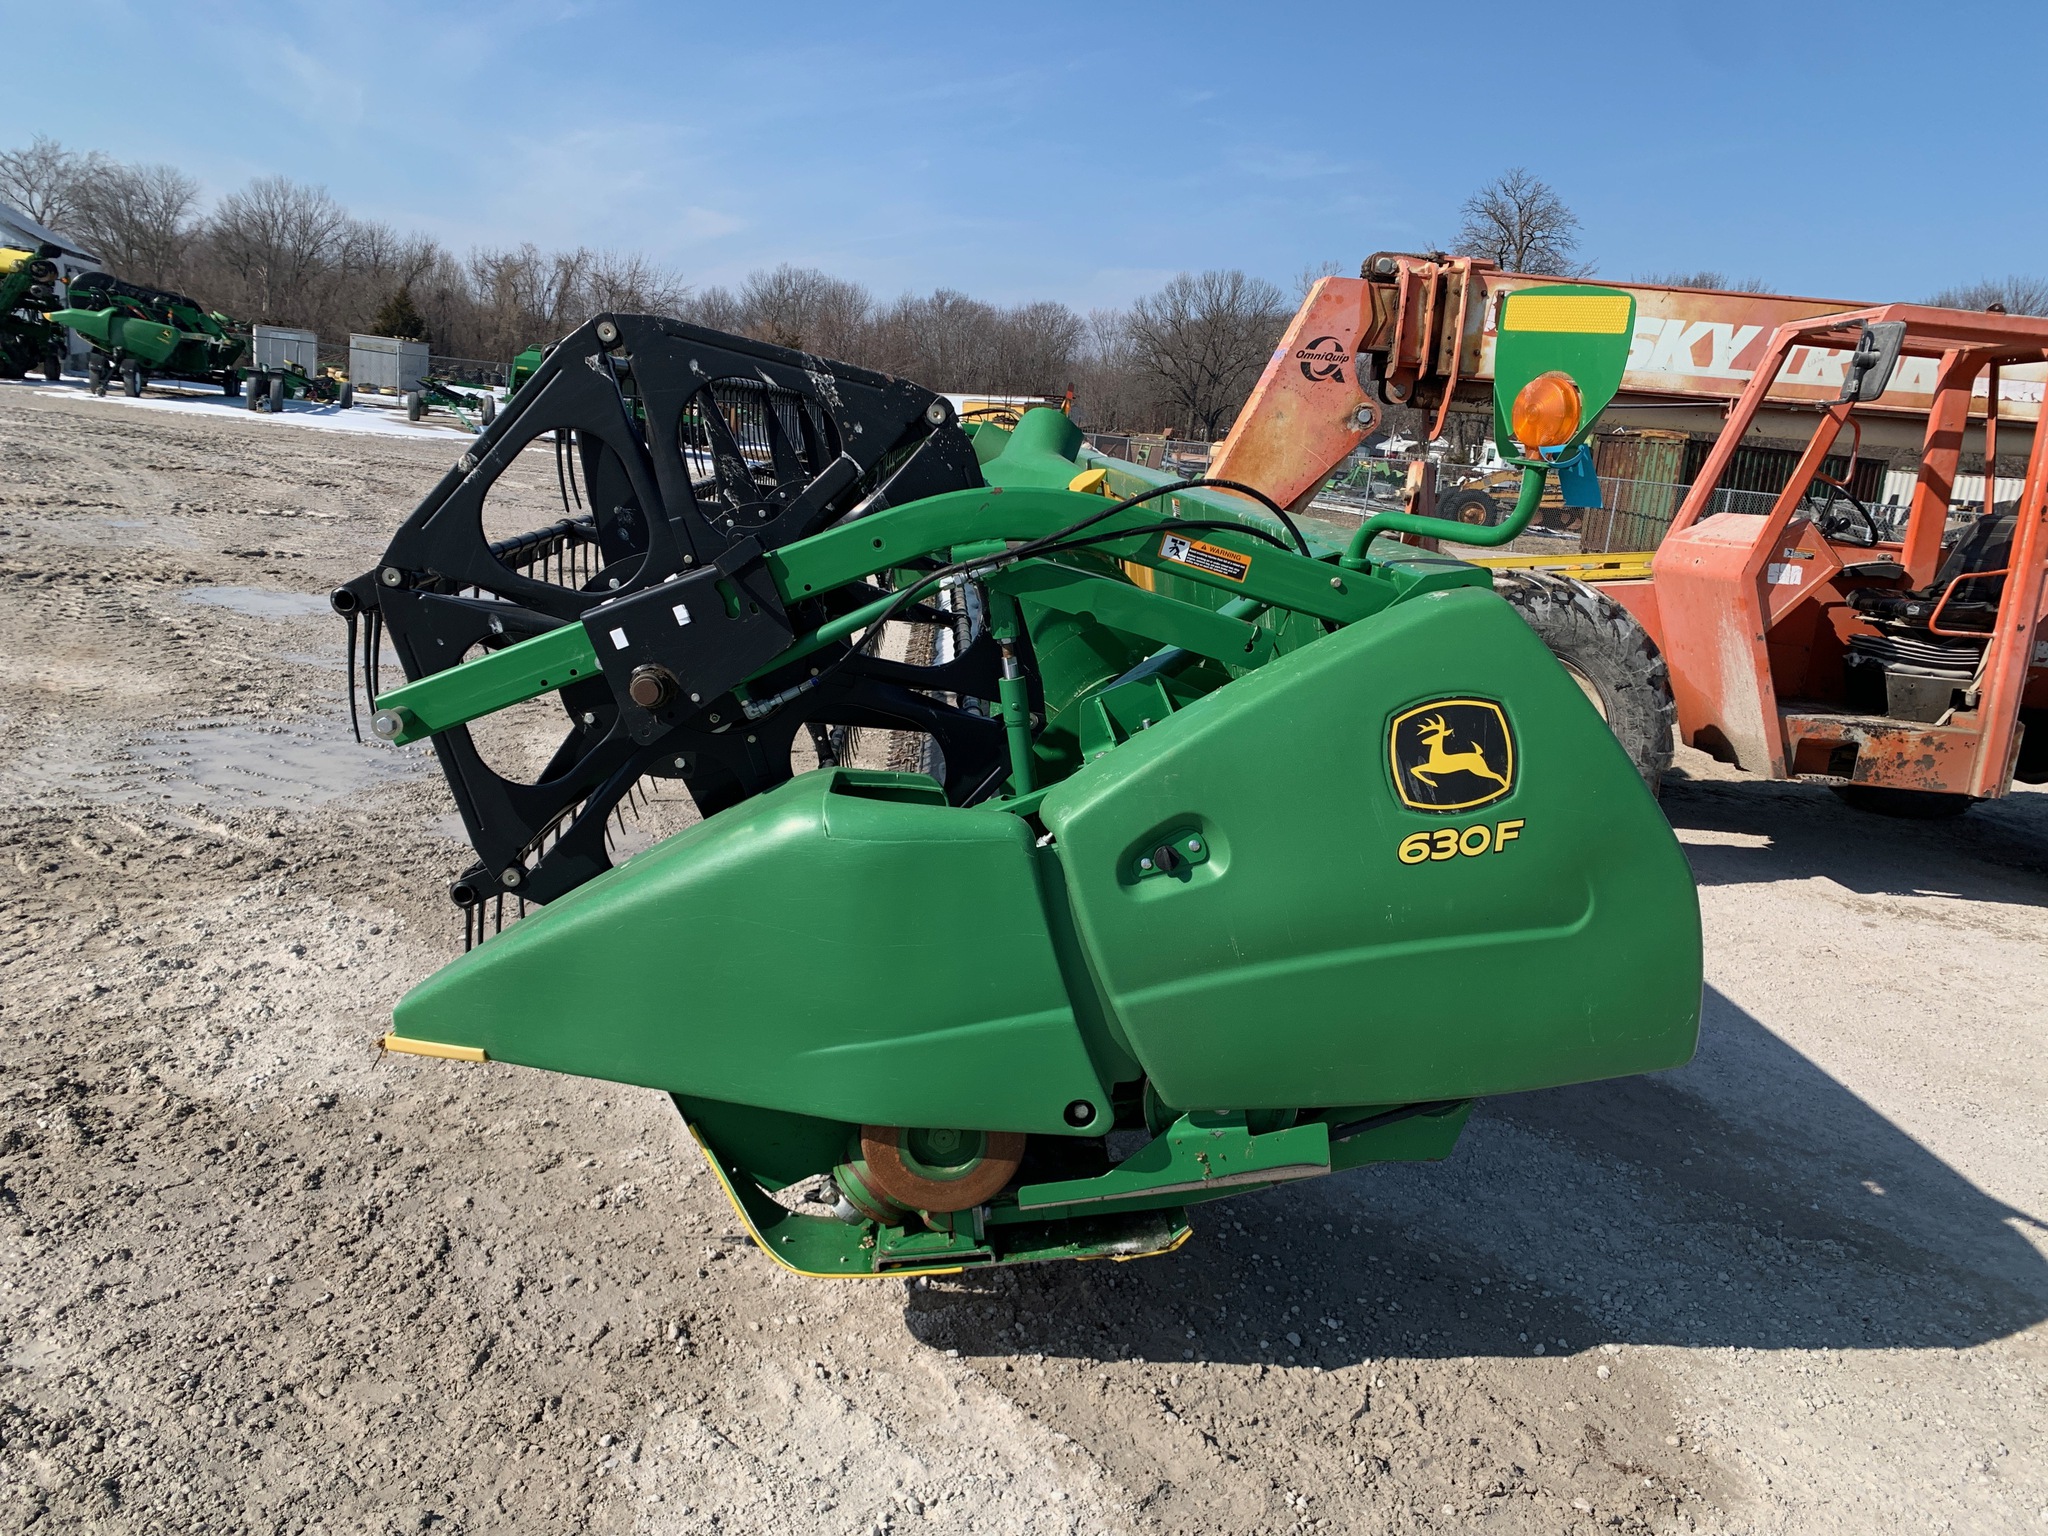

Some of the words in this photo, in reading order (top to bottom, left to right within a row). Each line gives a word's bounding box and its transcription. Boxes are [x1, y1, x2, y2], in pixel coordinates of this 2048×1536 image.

[1296, 350, 1350, 364] OmniQuip
[1209, 546, 1242, 561] WARNING
[1397, 818, 1526, 866] 630F
